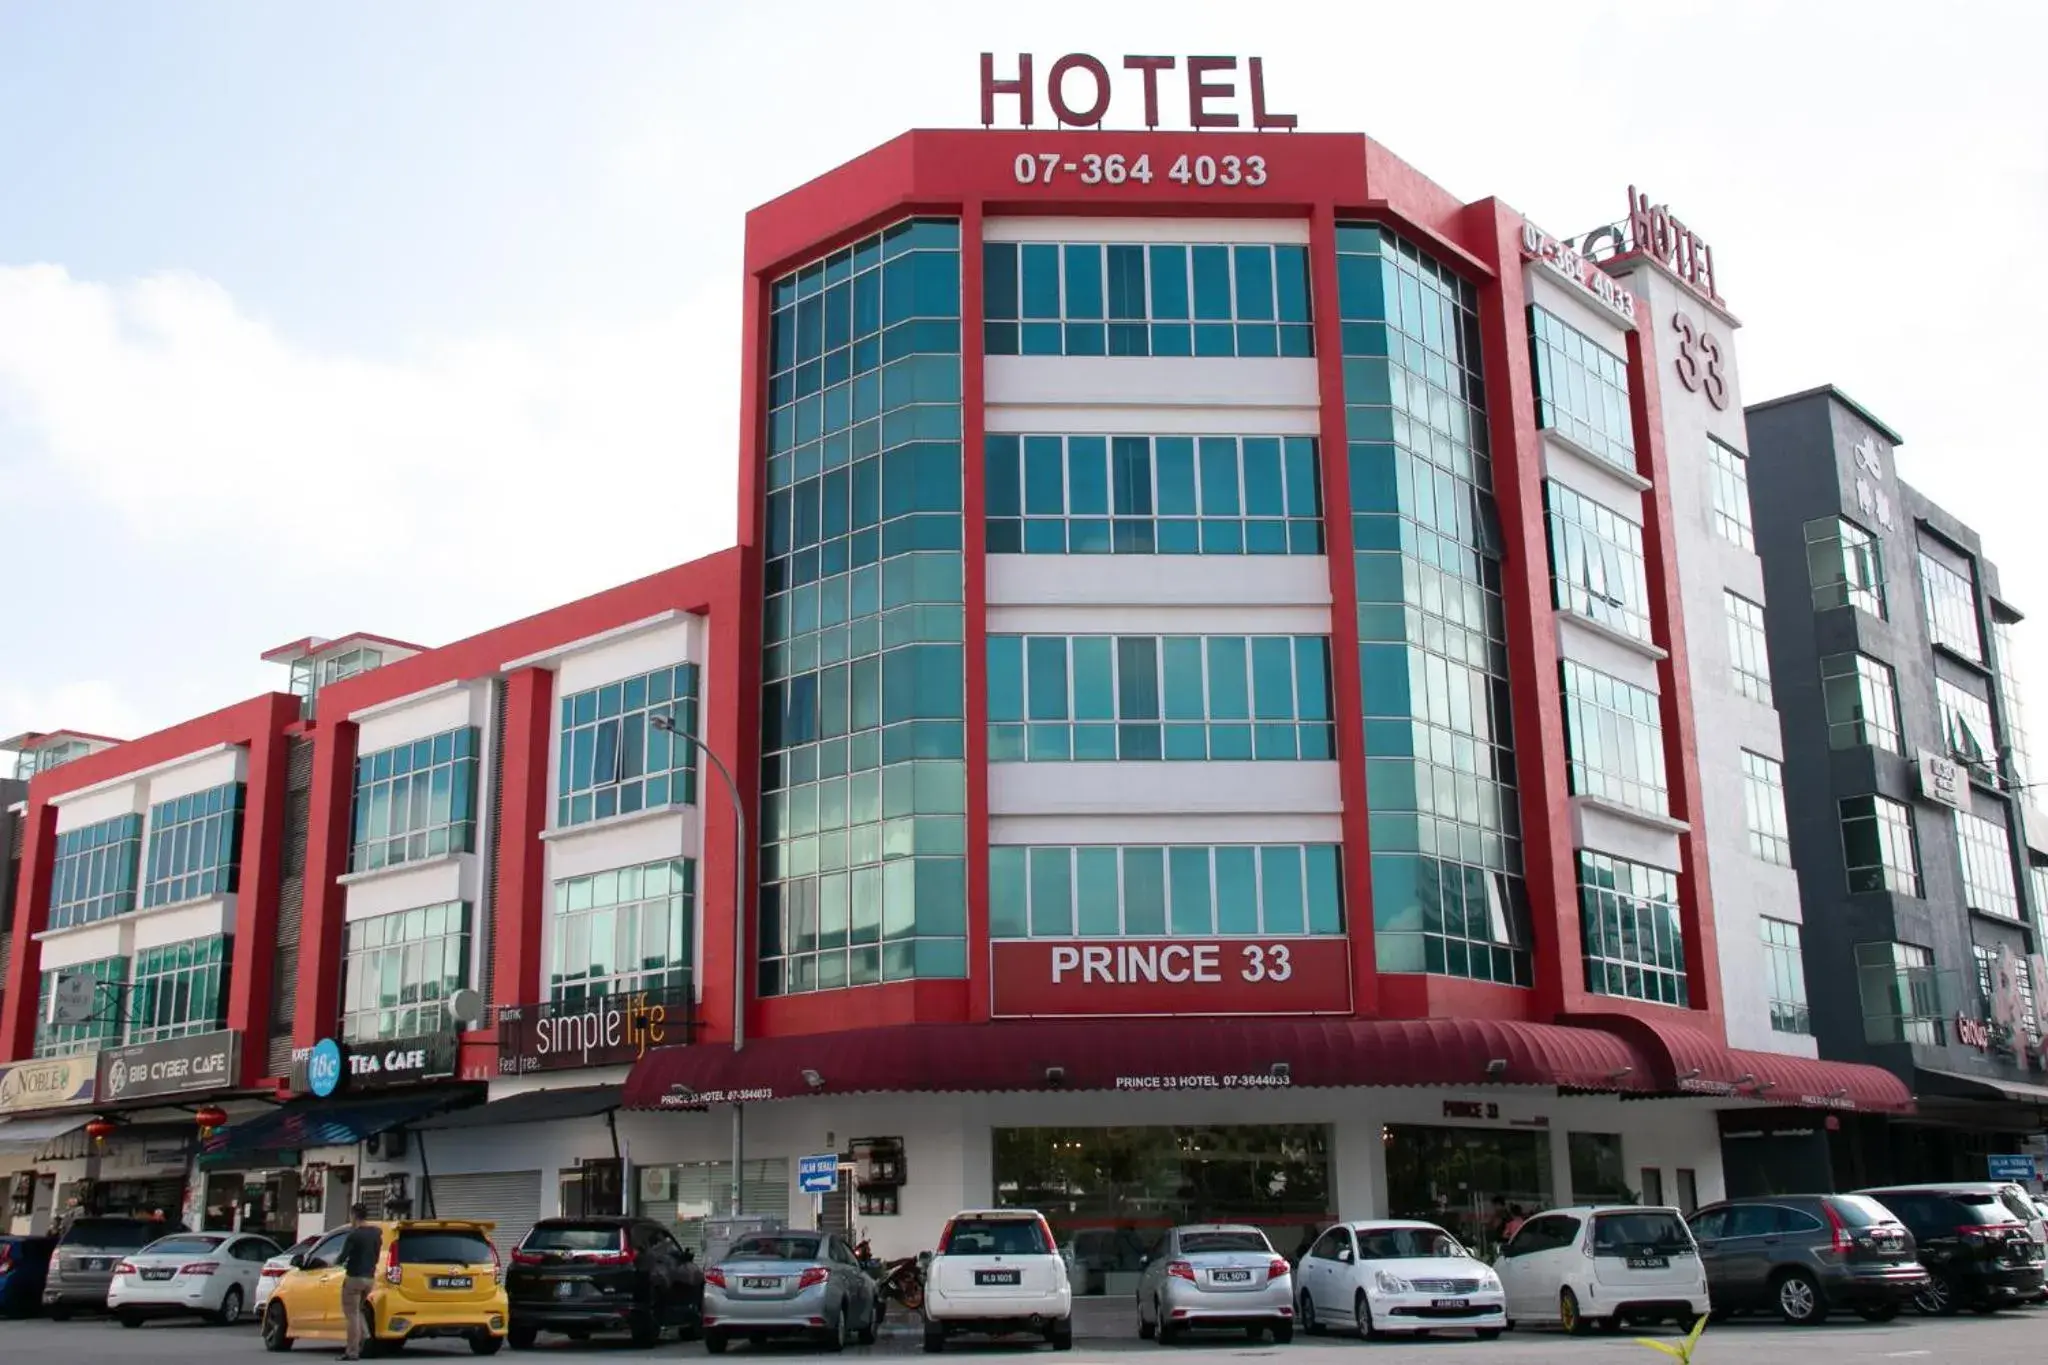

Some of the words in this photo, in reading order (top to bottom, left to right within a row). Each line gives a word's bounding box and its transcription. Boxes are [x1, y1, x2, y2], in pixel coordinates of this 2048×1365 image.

[980, 52, 1297, 126] HOTEL
[1014, 153, 1152, 184] 07-364
[1168, 154, 1267, 185] 4033
[1591, 271, 1634, 318] 4033
[1672, 309, 1729, 411] 33
[1052, 945, 1221, 983] PRINCE
[1242, 945, 1292, 983] 33
[536, 996, 621, 1064] simple
[627, 991, 665, 1060] life
[151, 1058, 189, 1080] CYBER
[193, 1053, 226, 1074] CAFE
[348, 1055, 381, 1075] TEA
[384, 1050, 426, 1071] CAFE
[17, 1068, 60, 1095] NOBLE
[700, 1090, 725, 1102] HOTEL
[1116, 1076, 1160, 1088] PRINCE
[1163, 1077, 1177, 1088] 33
[1180, 1076, 1220, 1087] HOTEL
[1223, 1074, 1291, 1086] 07-3644033
